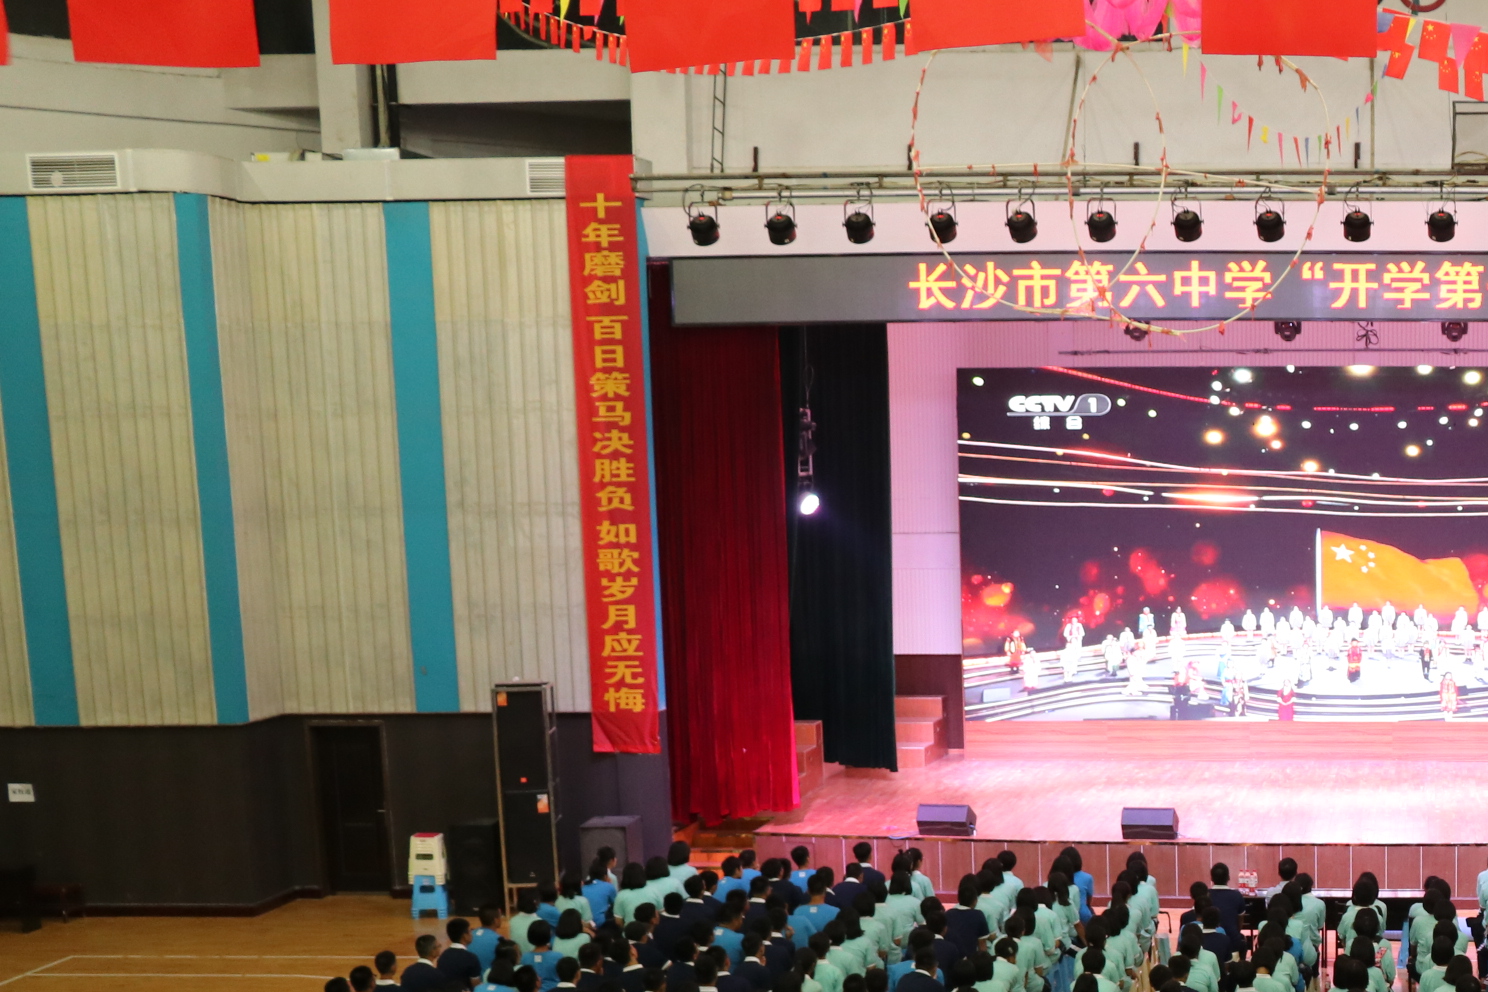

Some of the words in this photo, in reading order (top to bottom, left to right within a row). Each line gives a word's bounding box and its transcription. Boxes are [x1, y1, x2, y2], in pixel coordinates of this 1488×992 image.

[579, 192, 626, 305] 十年磨剑
[586, 315, 636, 512] 百日策马决胜负
[1008, 395, 1076, 413] CCTV
[1087, 397, 1098, 413] 1
[596, 520, 646, 713] 如歌岁月应无悔
